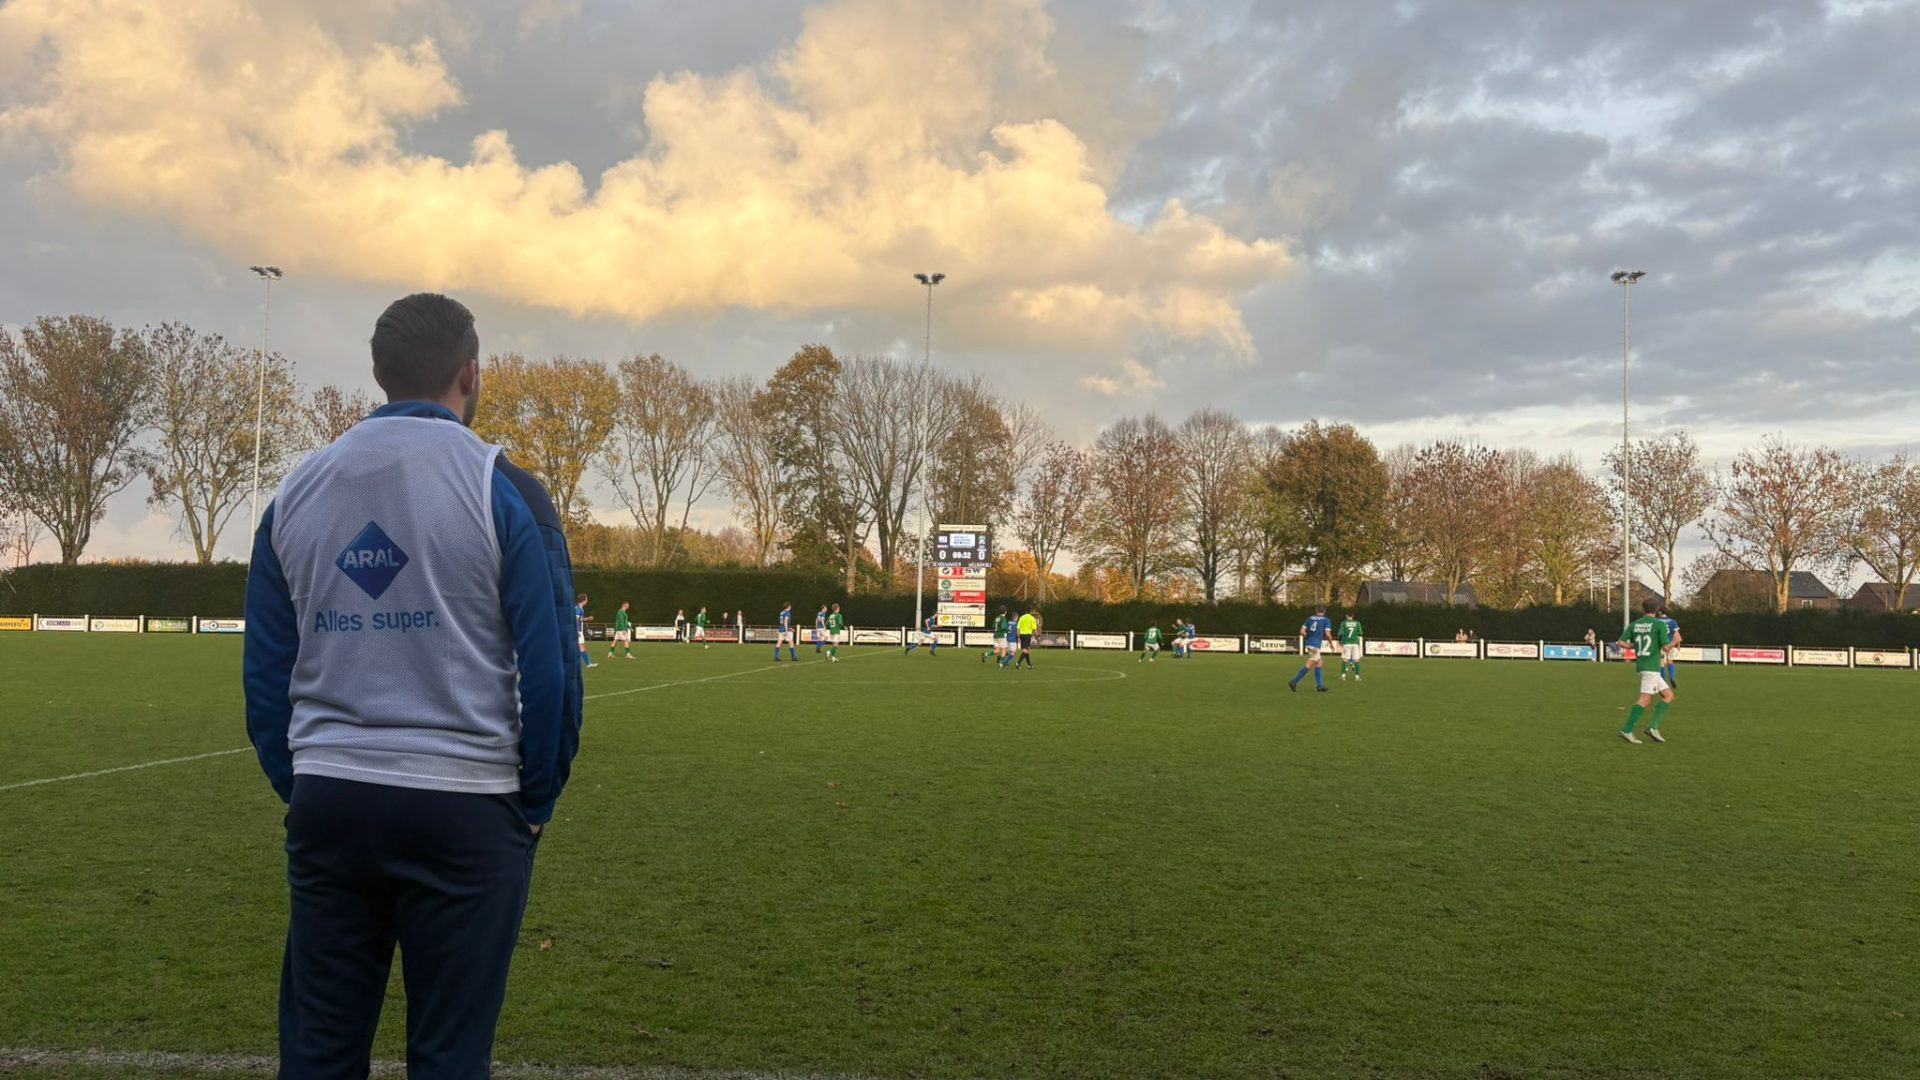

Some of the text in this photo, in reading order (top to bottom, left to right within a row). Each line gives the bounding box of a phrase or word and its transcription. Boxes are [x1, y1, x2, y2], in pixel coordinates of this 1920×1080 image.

[343, 548, 400, 569] ARAL
[314, 610, 440, 633] Alles super.
[1310, 621, 1318, 632] 4
[1347, 627, 1355, 638] 7
[1635, 635, 1652, 657] 12
